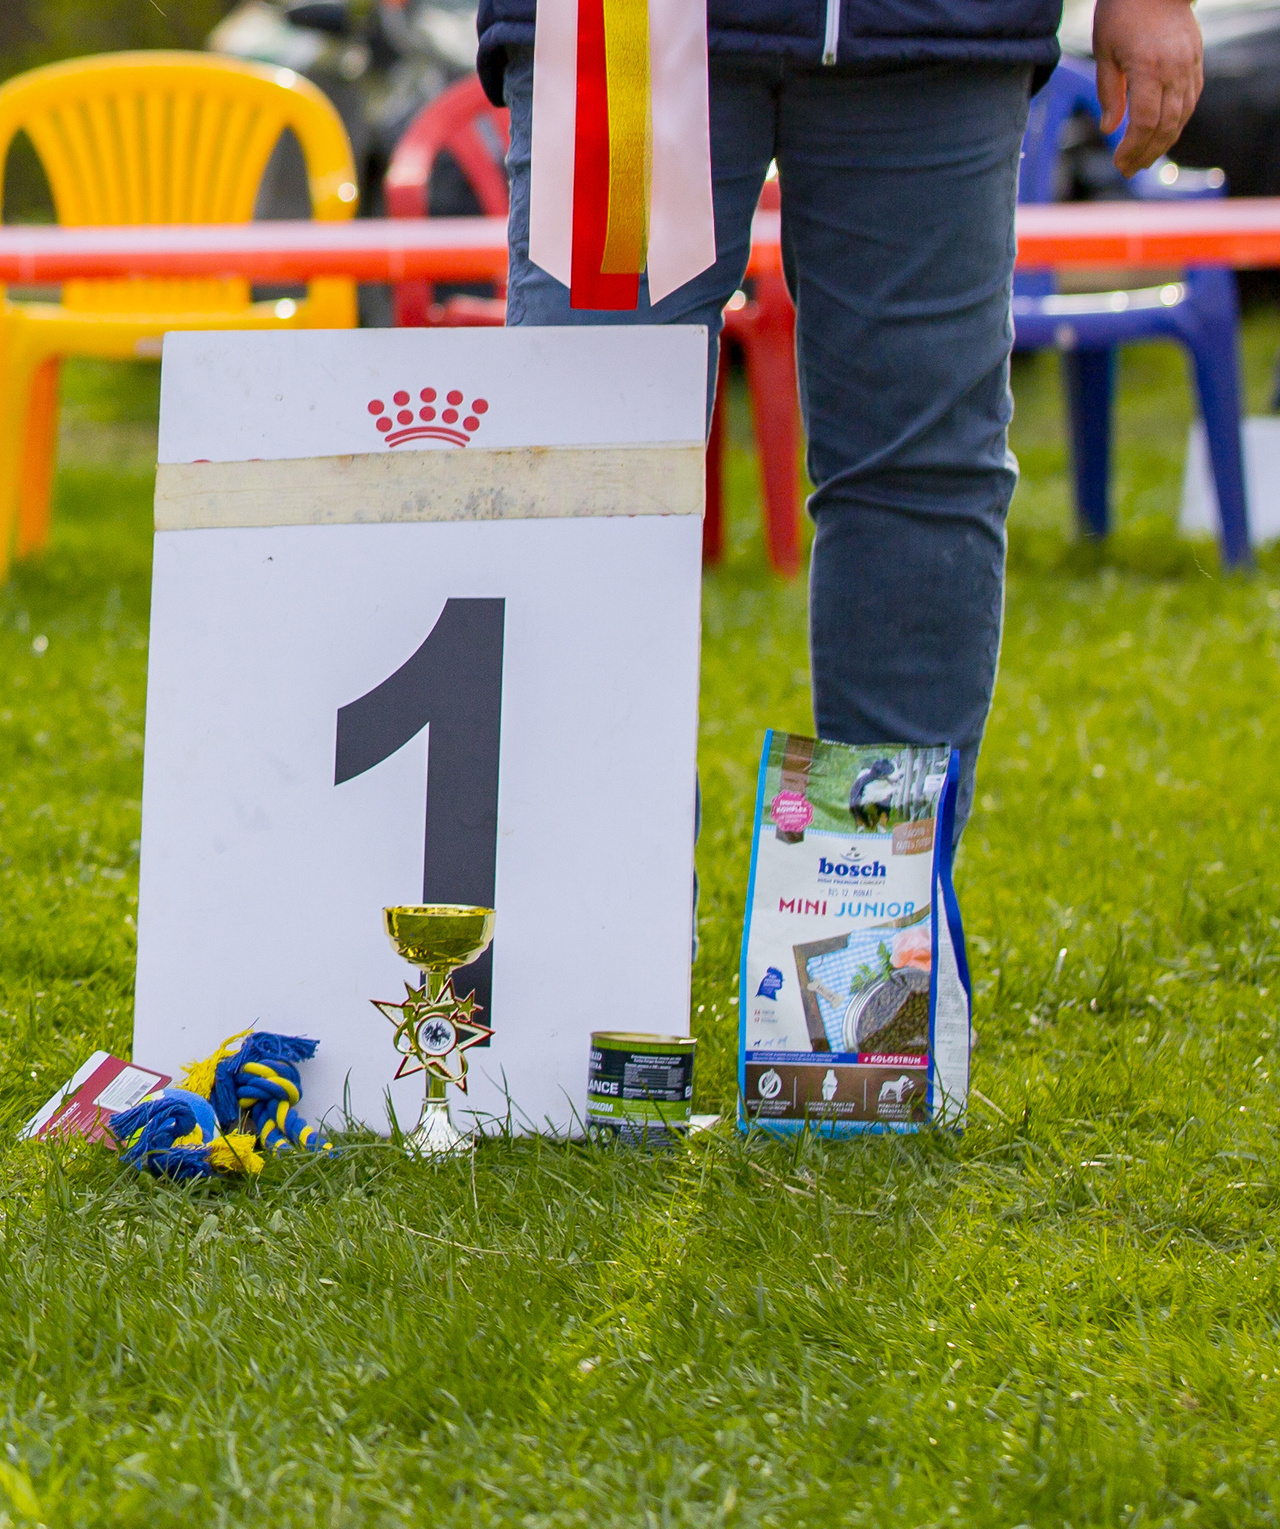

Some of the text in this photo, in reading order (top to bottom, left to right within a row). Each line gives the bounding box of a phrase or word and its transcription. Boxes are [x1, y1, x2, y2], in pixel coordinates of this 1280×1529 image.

[333, 596, 507, 1049] 1
[818, 856, 887, 878] bosch
[779, 896, 916, 918] MINI JUNIOR
[870, 1054, 922, 1065] KOLOSTRUM
